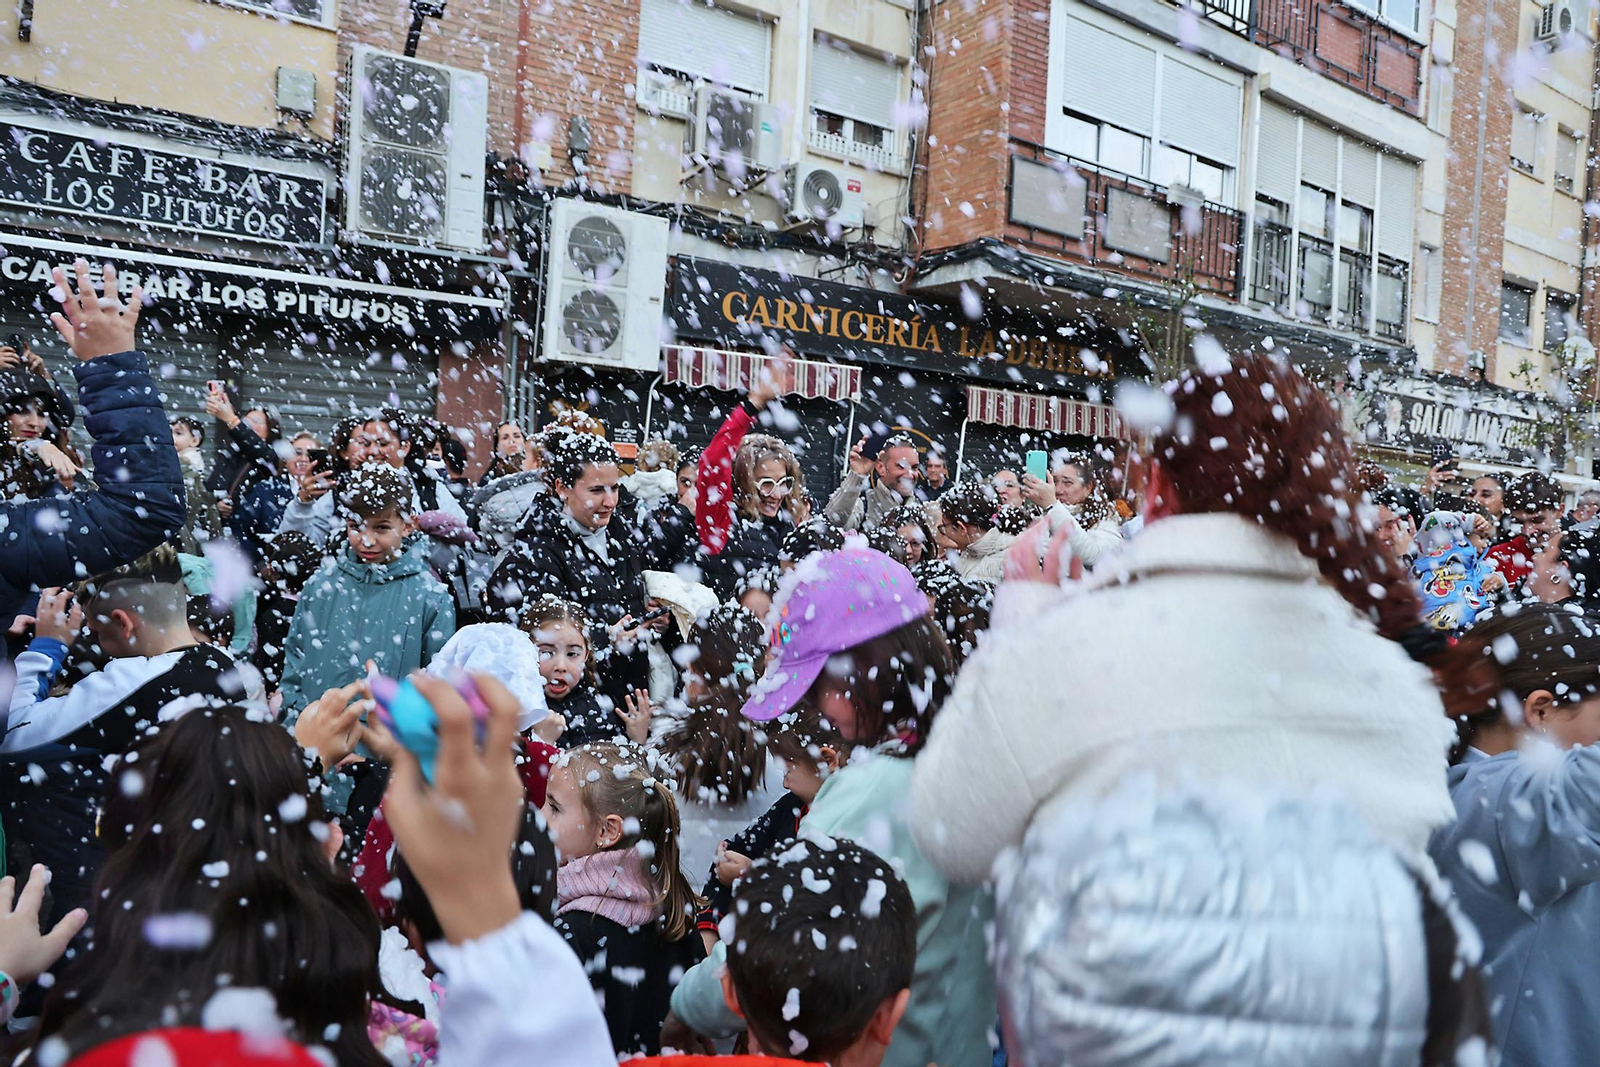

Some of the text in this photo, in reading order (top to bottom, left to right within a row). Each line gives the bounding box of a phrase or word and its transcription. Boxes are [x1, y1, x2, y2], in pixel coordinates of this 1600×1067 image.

[42, 172, 286, 240] LOS PITUFOS
[118, 269, 191, 300] BAR
[202, 281, 267, 310] LOS
[277, 291, 410, 326] PITUFOS
[722, 291, 1116, 381] CARNICERÍA LA DEHEA
[1409, 402, 1465, 440] SALON
